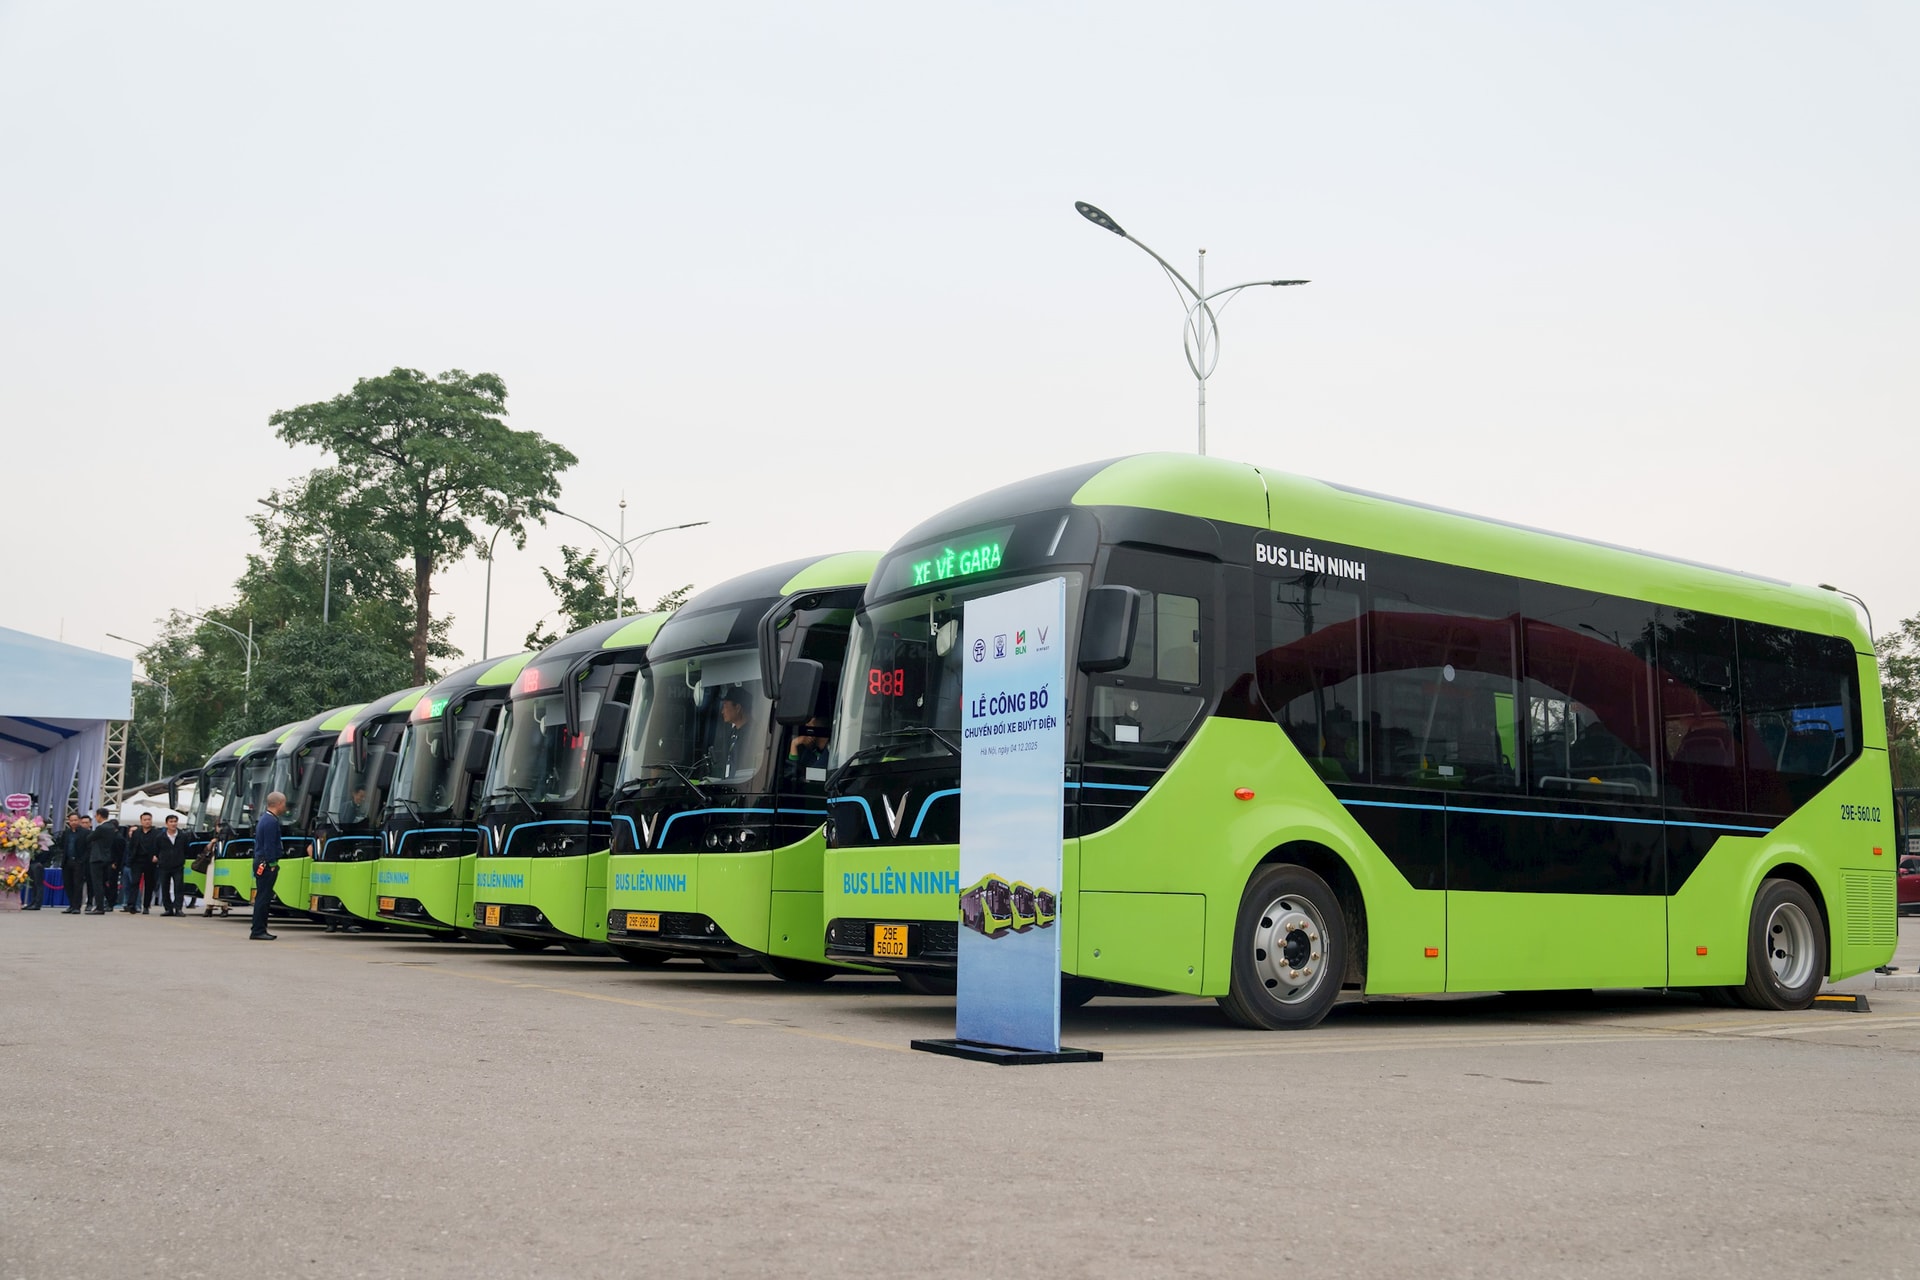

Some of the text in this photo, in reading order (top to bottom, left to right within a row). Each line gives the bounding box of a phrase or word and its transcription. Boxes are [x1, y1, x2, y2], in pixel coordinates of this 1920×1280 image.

[913, 543, 1001, 586] XE VỀ GARA
[1255, 543, 1366, 581] BUS LIÊN NINH
[1015, 645, 1027, 655] BLN
[972, 683, 1049, 718] LỄ CÔNG BỐ
[1007, 722, 1017, 733] XE
[1017, 717, 1038, 732] BUÝT
[1038, 714, 1057, 731] ĐIỆN
[1840, 804, 1881, 822] 29E-560.02
[502, 873, 524, 889] NINH
[615, 868, 687, 892] BUS LIÊN NINH
[843, 866, 960, 895] BUS LIÊN NINH
[883, 927, 898, 940] 29E
[877, 941, 904, 956] 560.02
